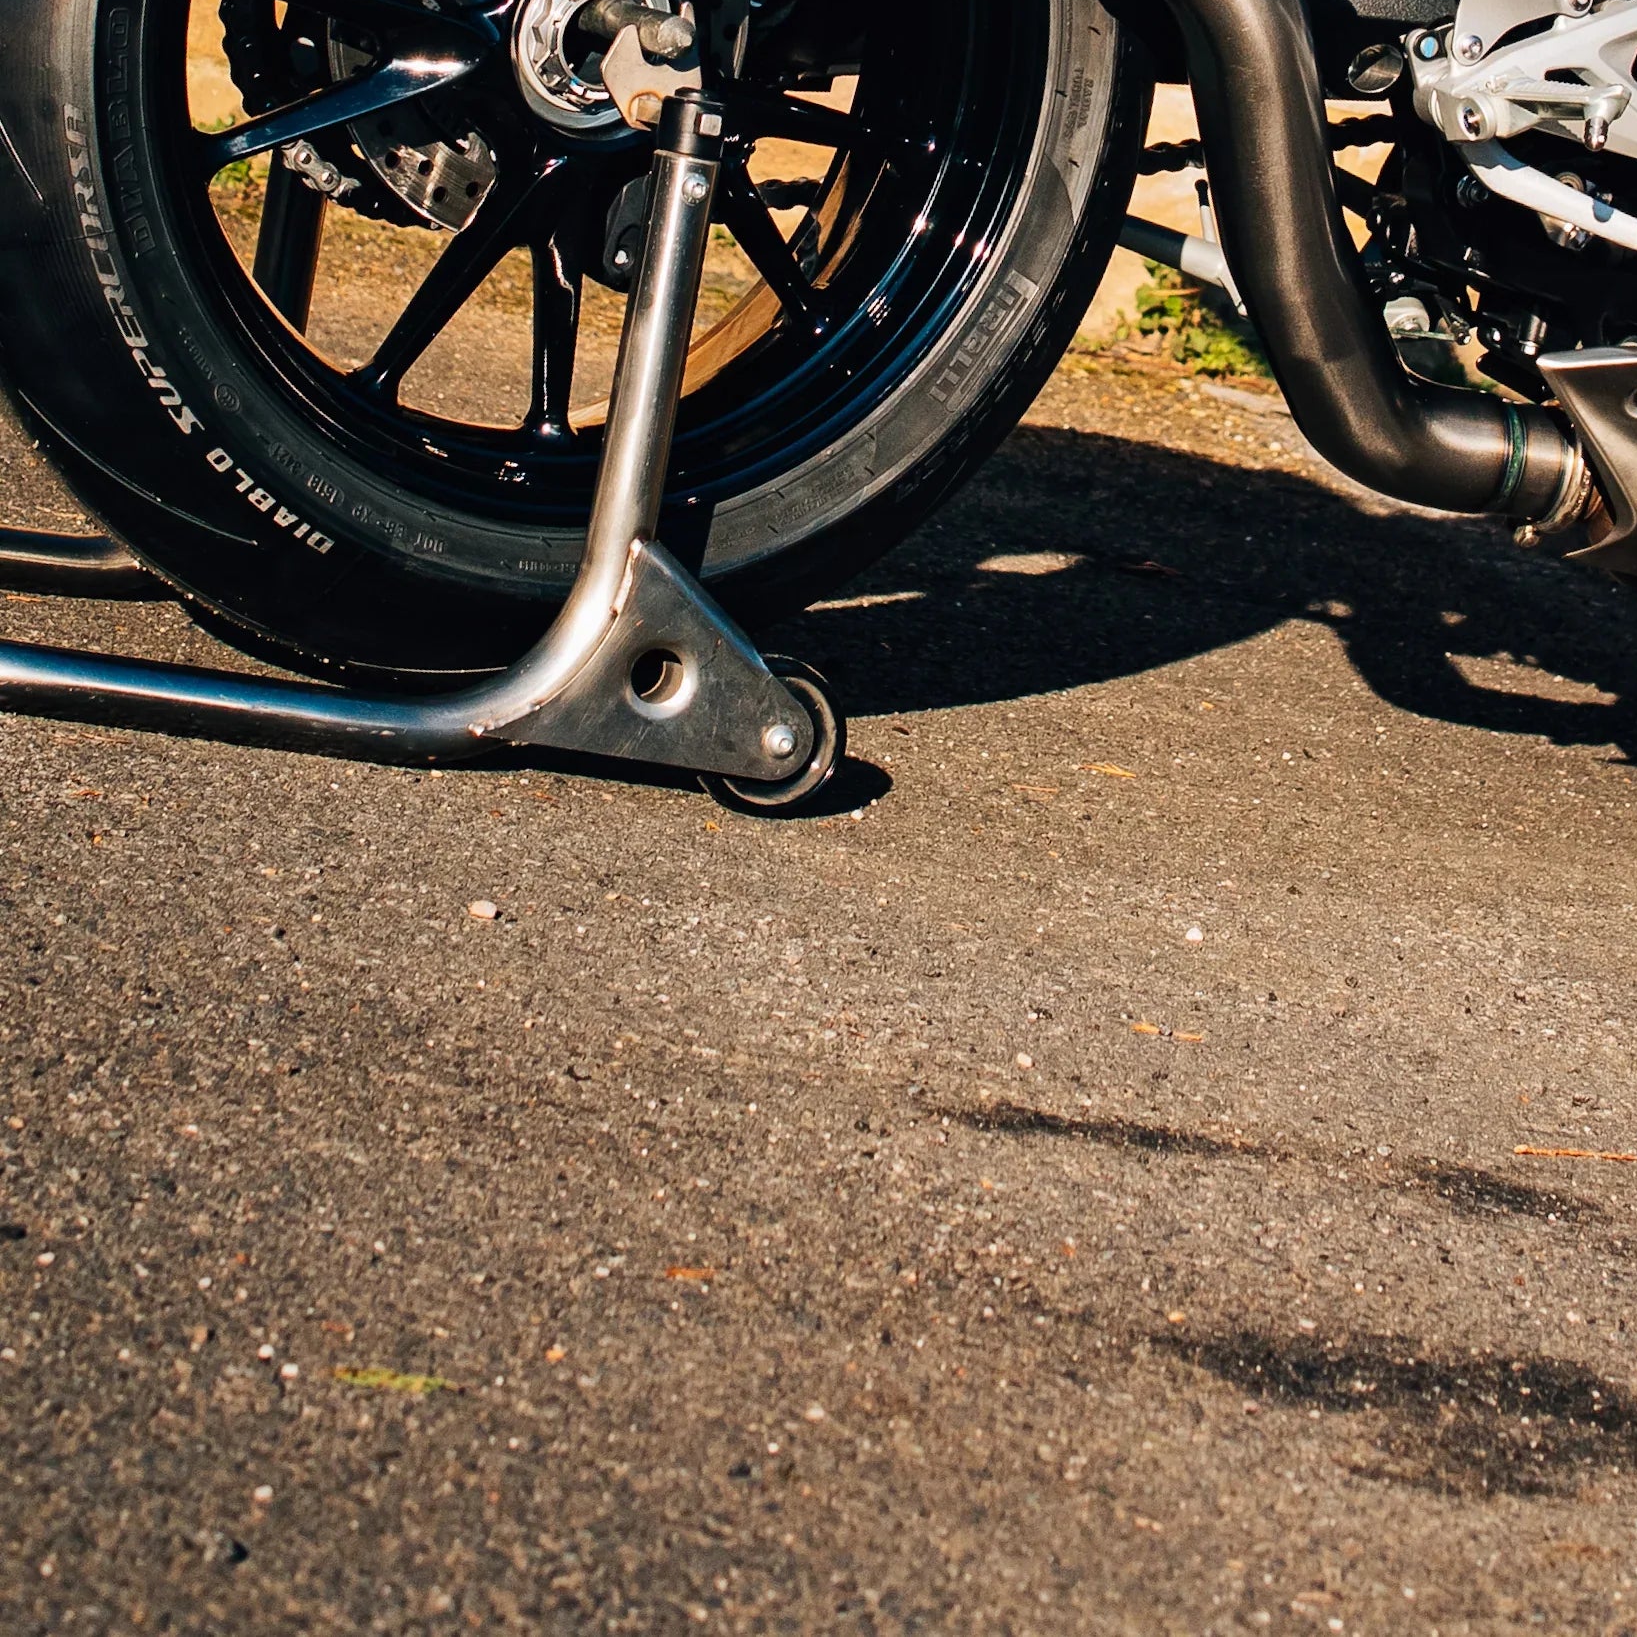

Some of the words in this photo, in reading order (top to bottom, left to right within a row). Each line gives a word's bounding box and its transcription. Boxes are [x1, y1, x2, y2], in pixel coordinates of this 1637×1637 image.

[107, 7, 157, 254] DIABLO
[63, 103, 206, 435] SUPERCORSA
[928, 269, 1040, 413] PIRELLI
[206, 448, 336, 554] DIABLO
